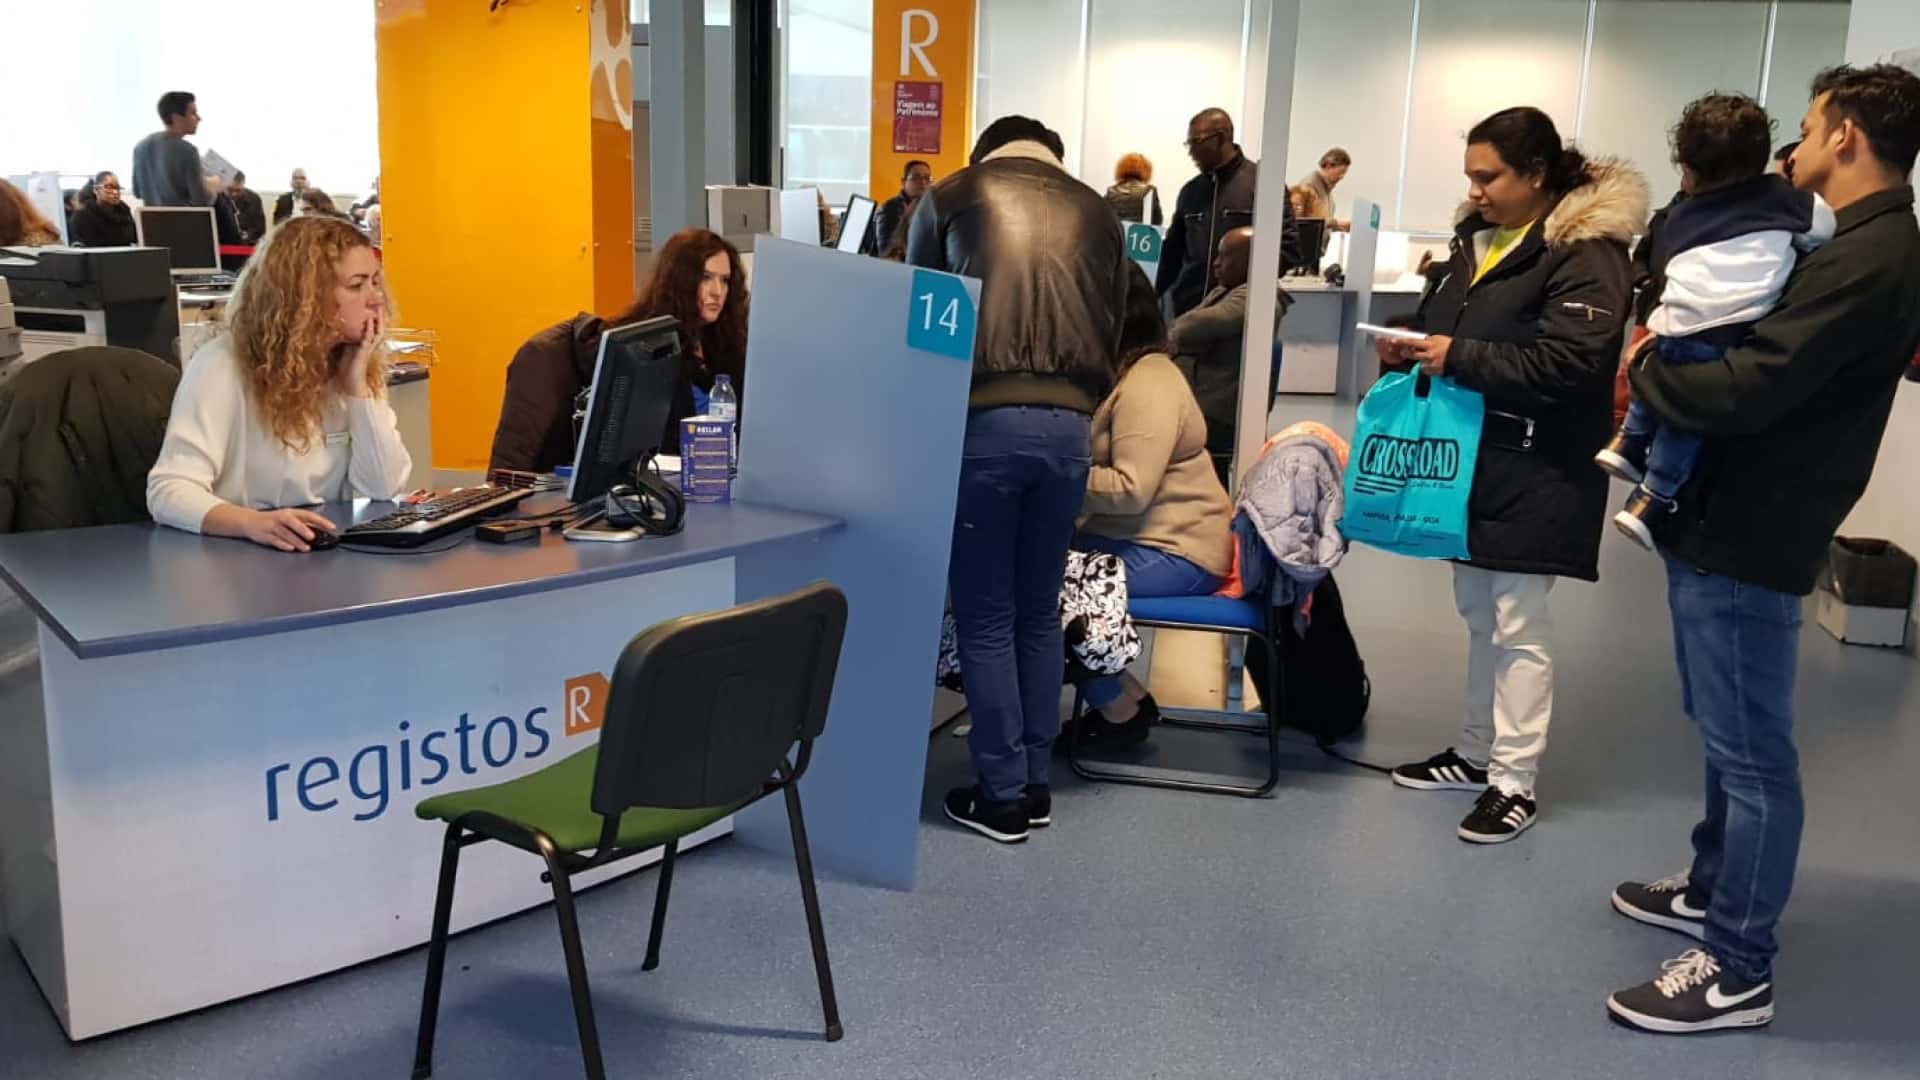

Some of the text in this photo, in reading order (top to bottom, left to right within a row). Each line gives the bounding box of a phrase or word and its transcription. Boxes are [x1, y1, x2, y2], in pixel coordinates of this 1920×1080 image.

[900, 8, 939, 77] R
[1129, 233, 1151, 253] 16
[919, 292, 959, 337] 14
[265, 686, 591, 821] registos R
